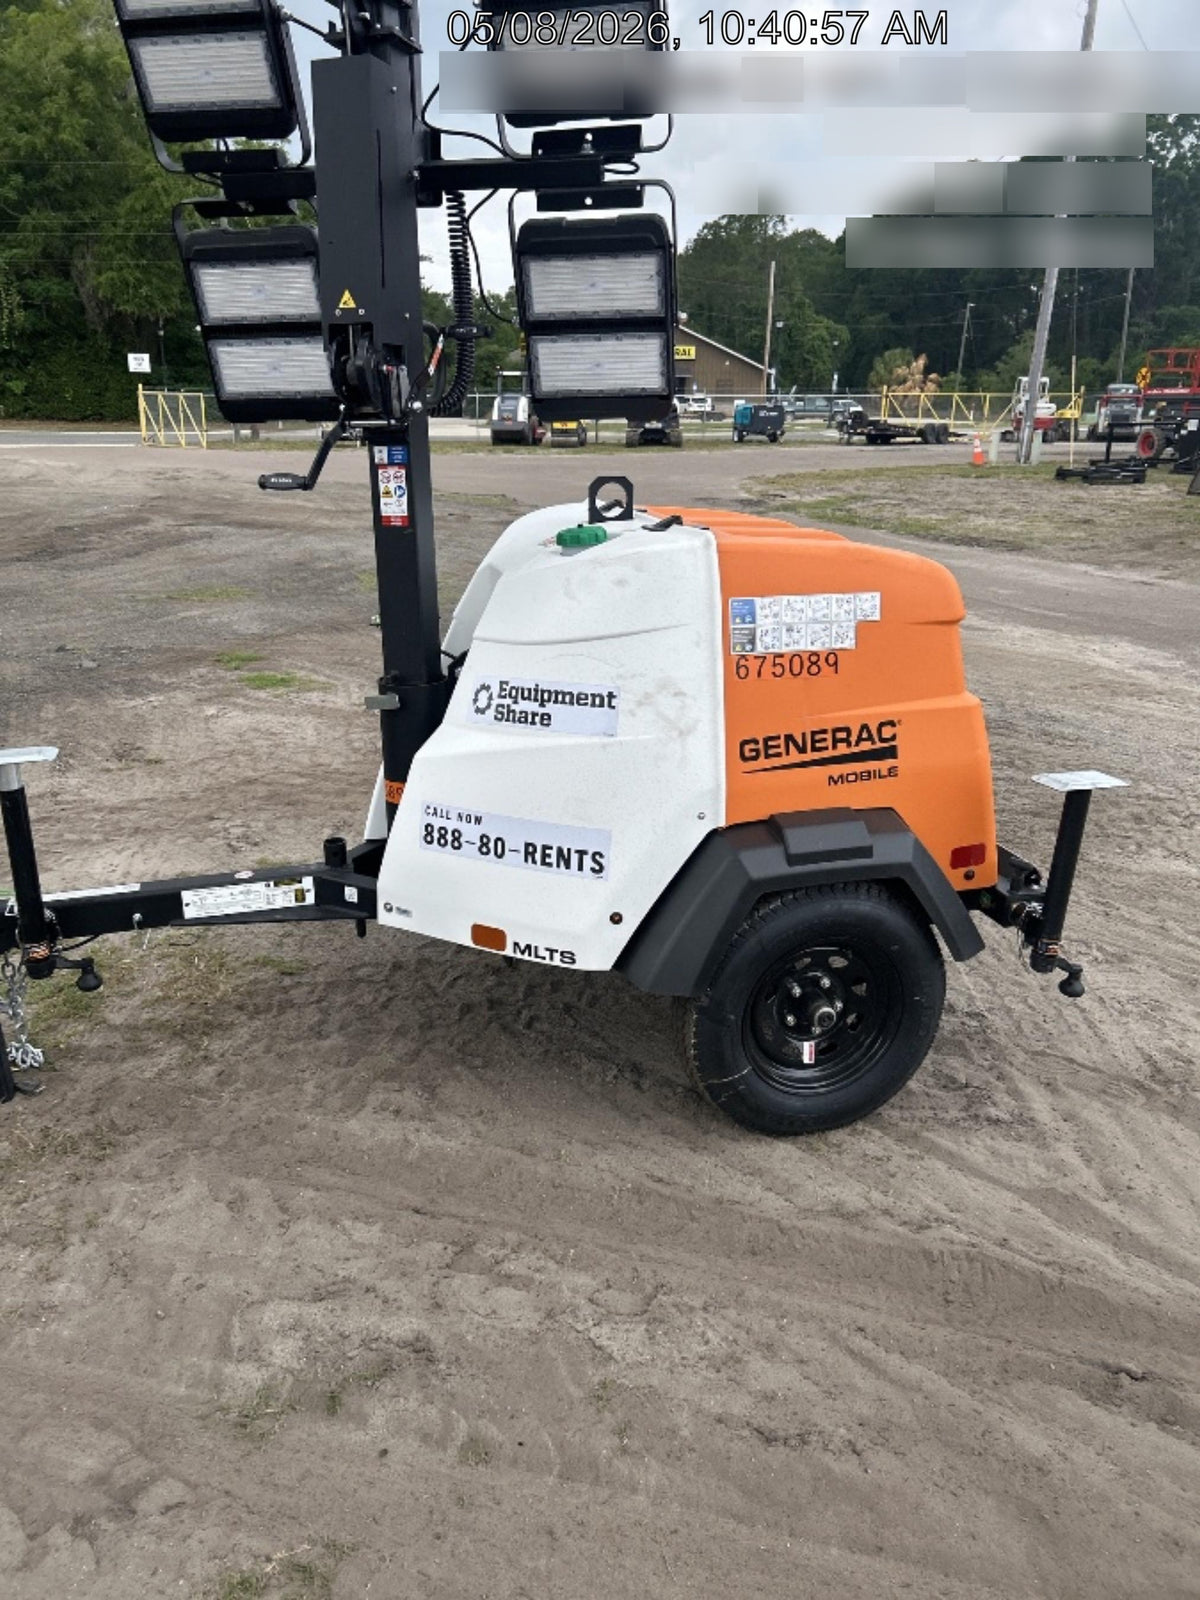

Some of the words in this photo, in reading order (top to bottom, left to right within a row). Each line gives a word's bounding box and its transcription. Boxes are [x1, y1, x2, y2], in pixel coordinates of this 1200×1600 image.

[735, 652, 839, 680] 675089
[497, 680, 617, 710] Equipment
[493, 703, 552, 728] Share
[739, 719, 898, 763] GENERAC
[827, 765, 899, 787] MOBILE
[424, 805, 452, 821] CALL
[457, 811, 483, 826] NOW
[422, 822, 606, 875] 888-80-RENTS
[512, 941, 577, 965] MLTS
